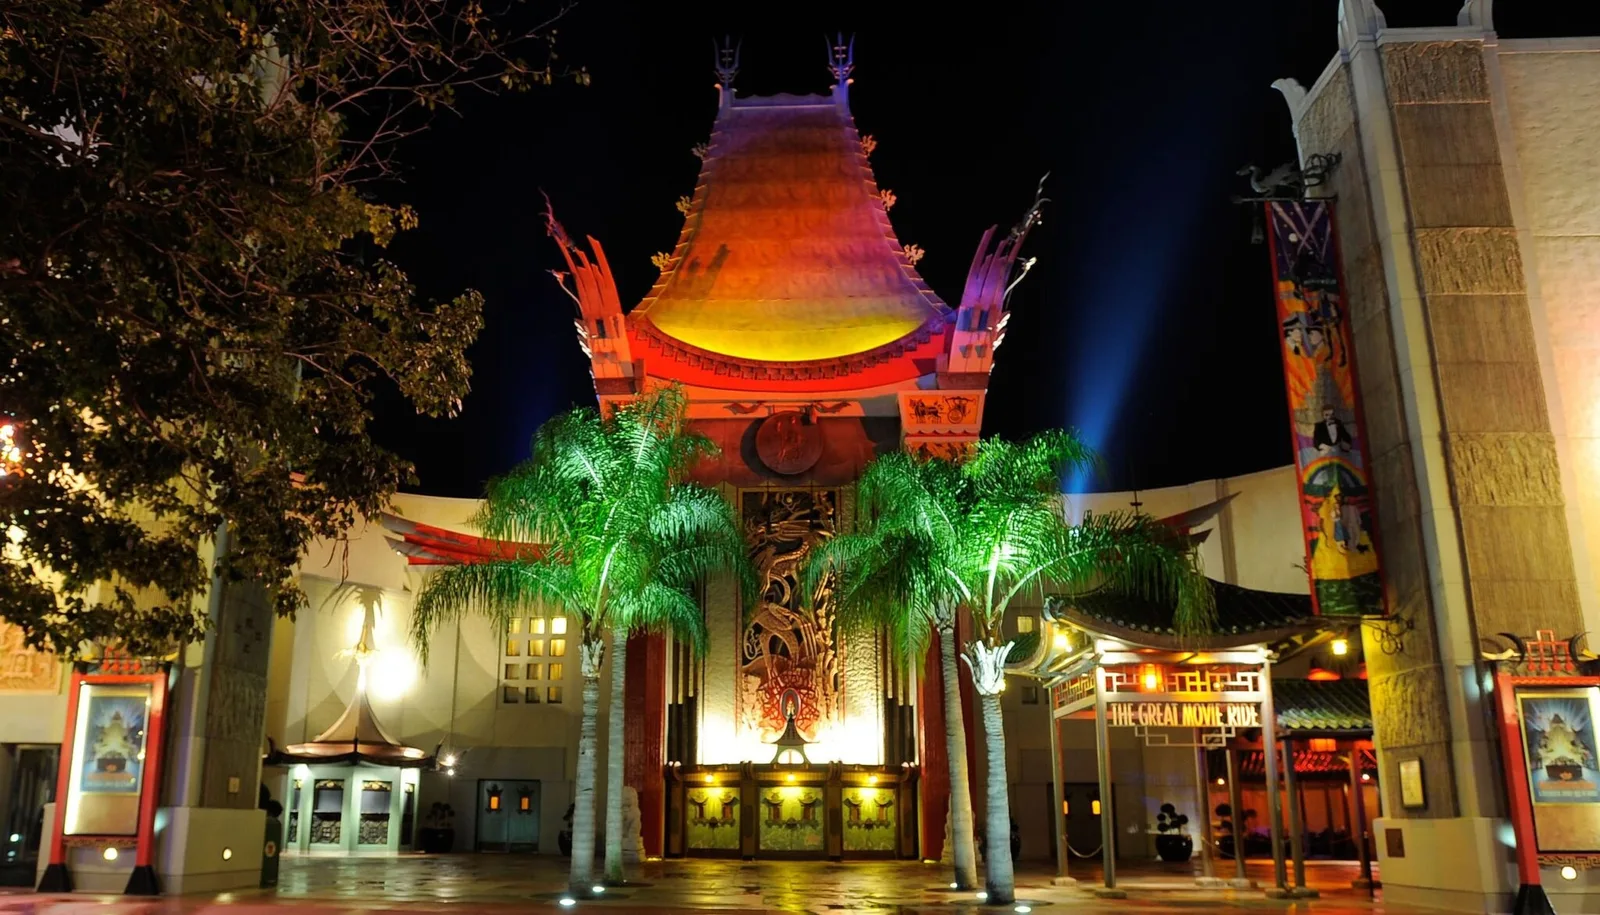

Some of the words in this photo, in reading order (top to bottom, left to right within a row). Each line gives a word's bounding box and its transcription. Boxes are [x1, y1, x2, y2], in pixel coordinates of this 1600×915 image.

[1111, 703, 1135, 726] THE
[1138, 703, 1180, 726] GREAT
[1182, 703, 1223, 726] MOVIE
[1226, 703, 1259, 726] RIDE
